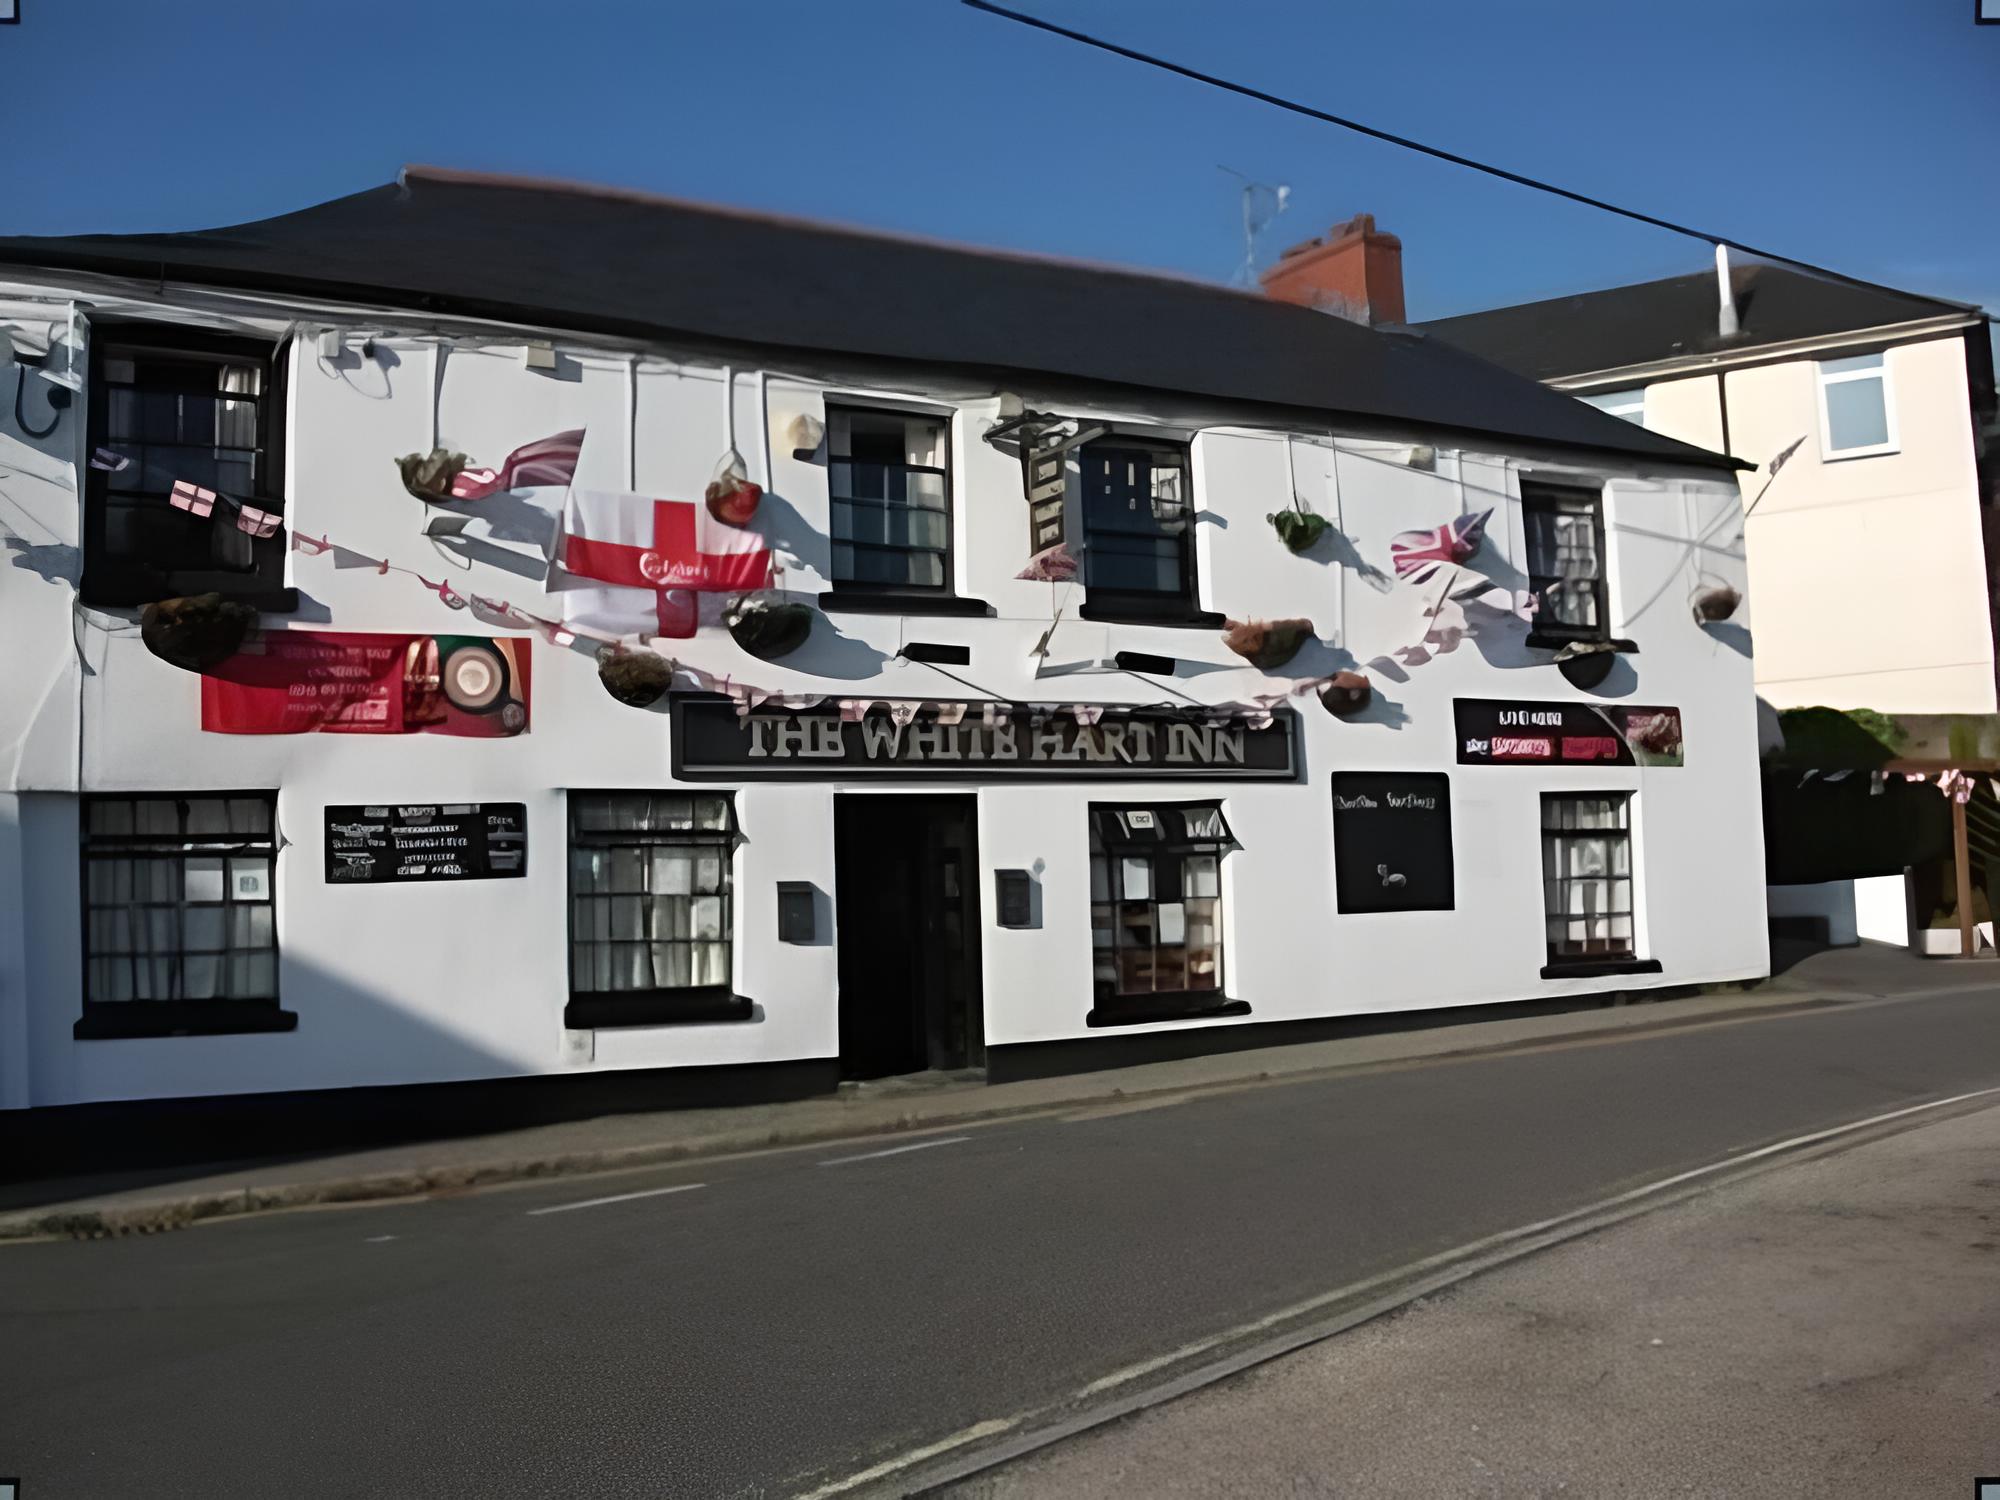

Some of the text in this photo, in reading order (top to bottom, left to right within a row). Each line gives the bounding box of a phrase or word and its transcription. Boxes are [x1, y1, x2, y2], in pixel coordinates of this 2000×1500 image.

[740, 714, 1244, 763] THE WHITE HART INN
